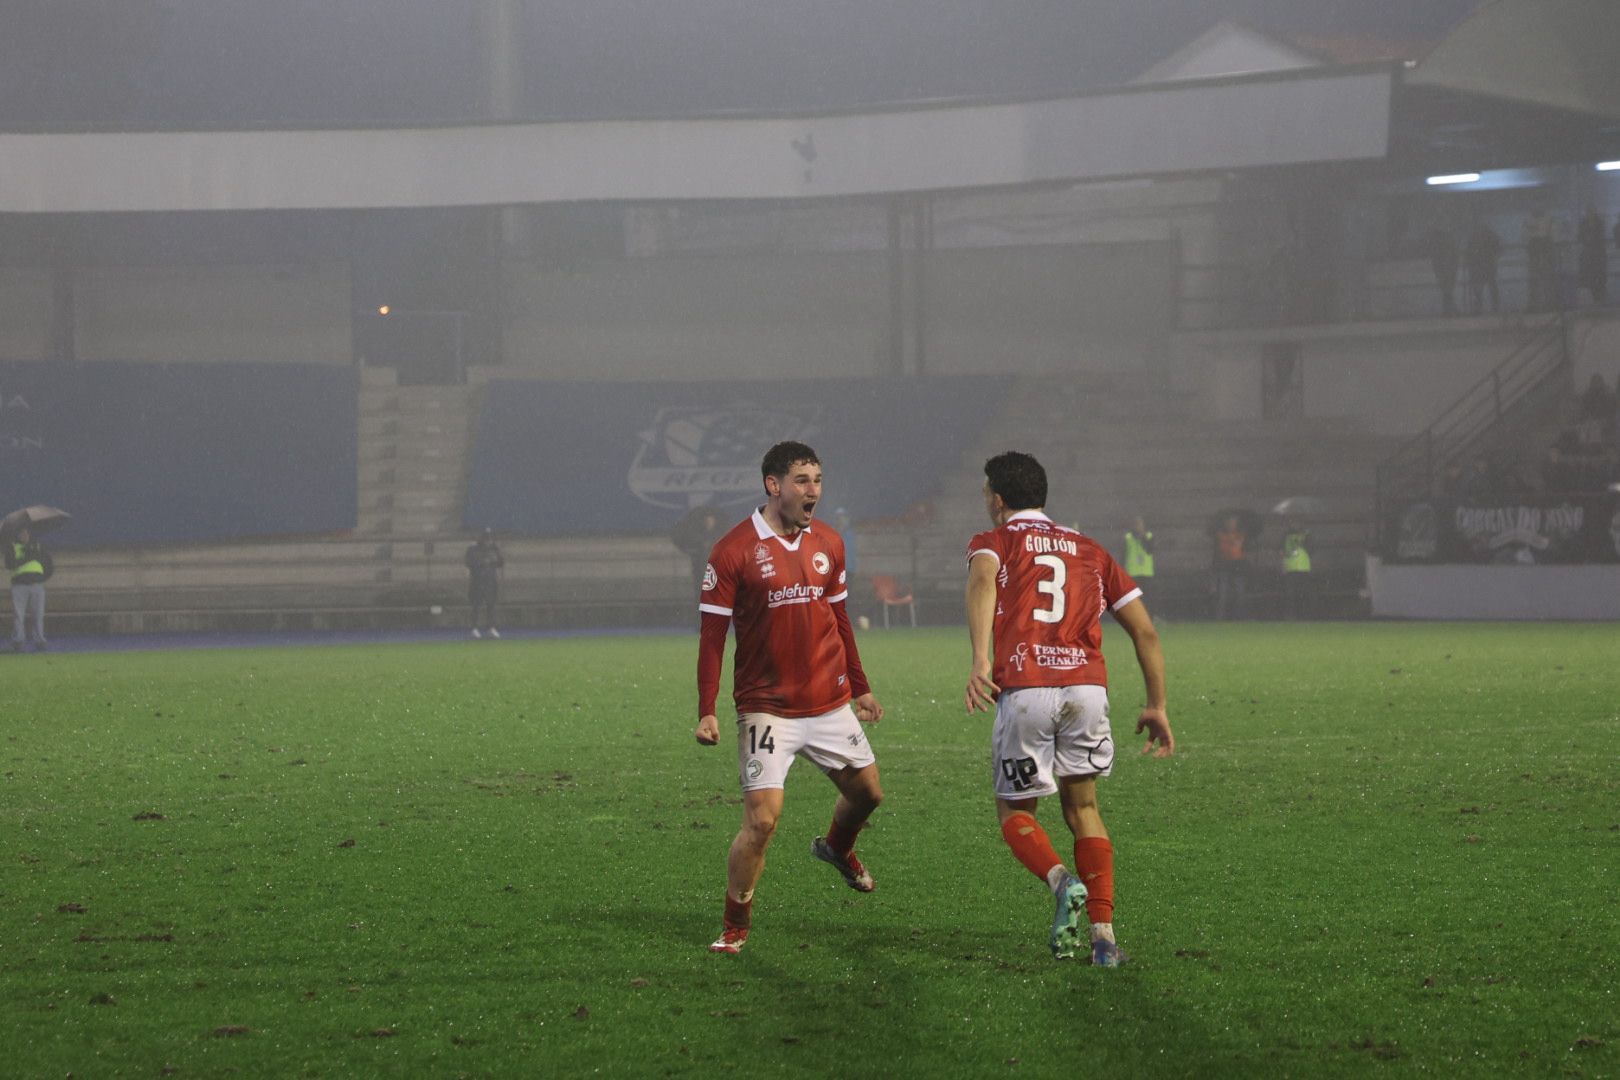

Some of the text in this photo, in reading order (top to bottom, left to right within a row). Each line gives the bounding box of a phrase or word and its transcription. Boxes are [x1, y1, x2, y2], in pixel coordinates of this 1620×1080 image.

[1025, 534, 1078, 556] GORJÓN
[768, 582, 824, 602] telefurgo
[1033, 554, 1067, 623] 3
[1033, 644, 1086, 659] TERNERA
[1037, 655, 1089, 667] CHARRA
[748, 724, 775, 755] 14
